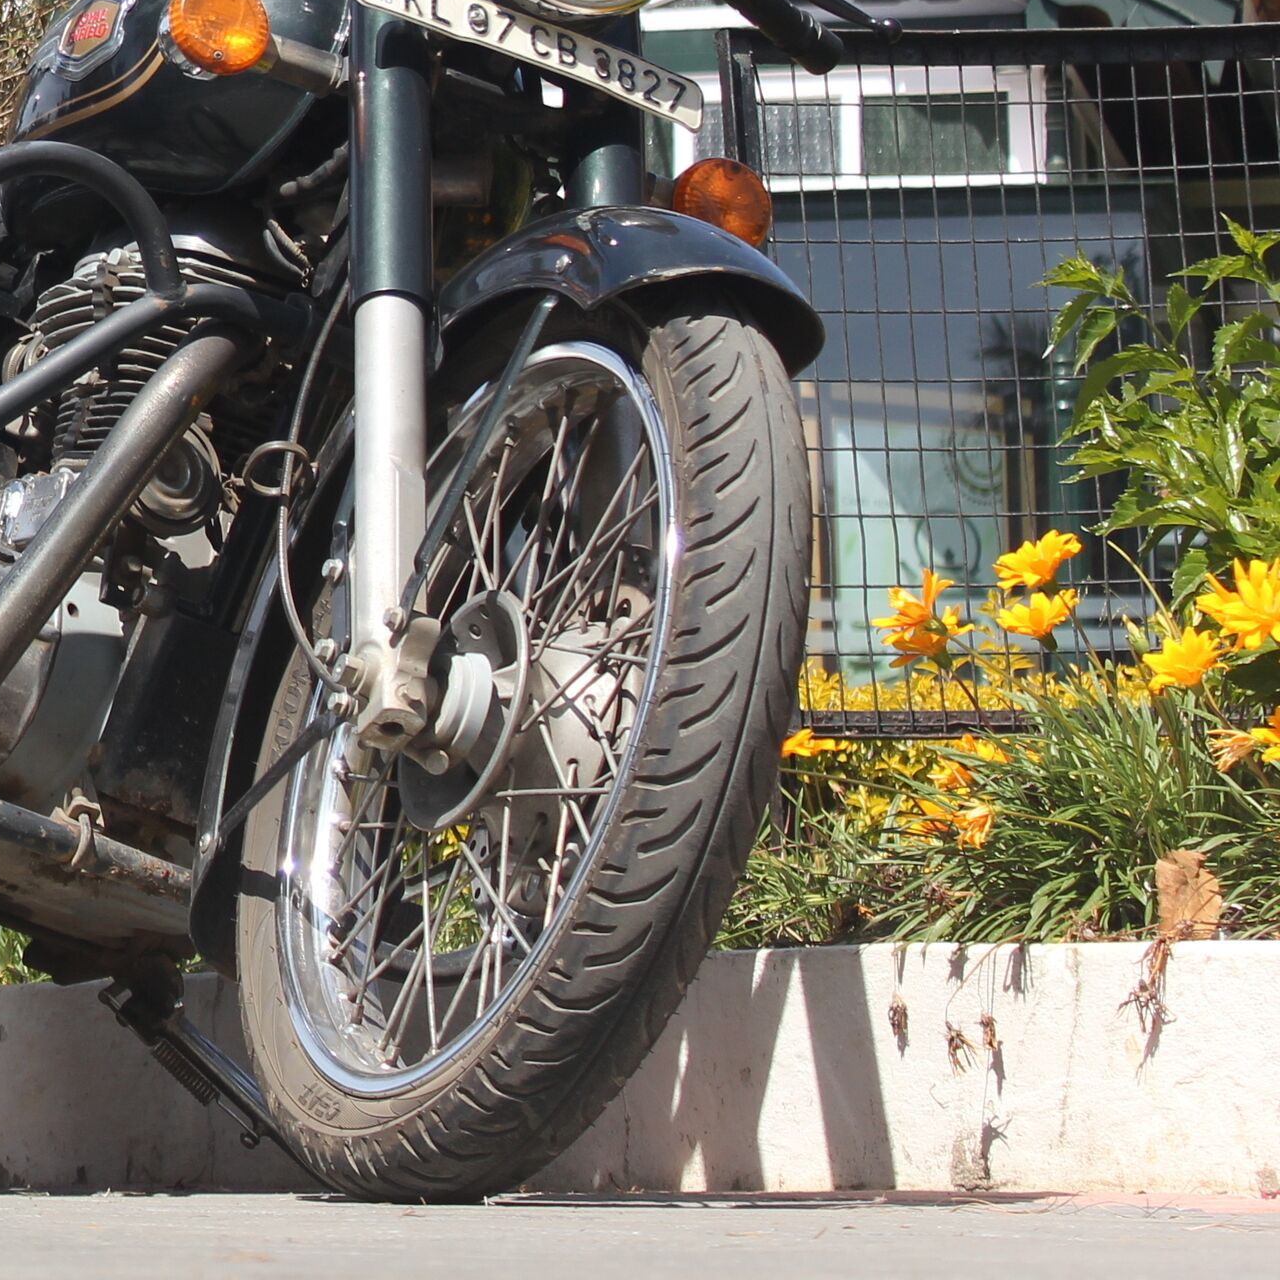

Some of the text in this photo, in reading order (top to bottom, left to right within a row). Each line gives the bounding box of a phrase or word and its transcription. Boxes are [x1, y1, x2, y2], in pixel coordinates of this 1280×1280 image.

[468, 3, 516, 44] 07
[530, 24, 577, 67] CB
[593, 47, 687, 111] 3827
[297, 1081, 341, 1121] CEAT
